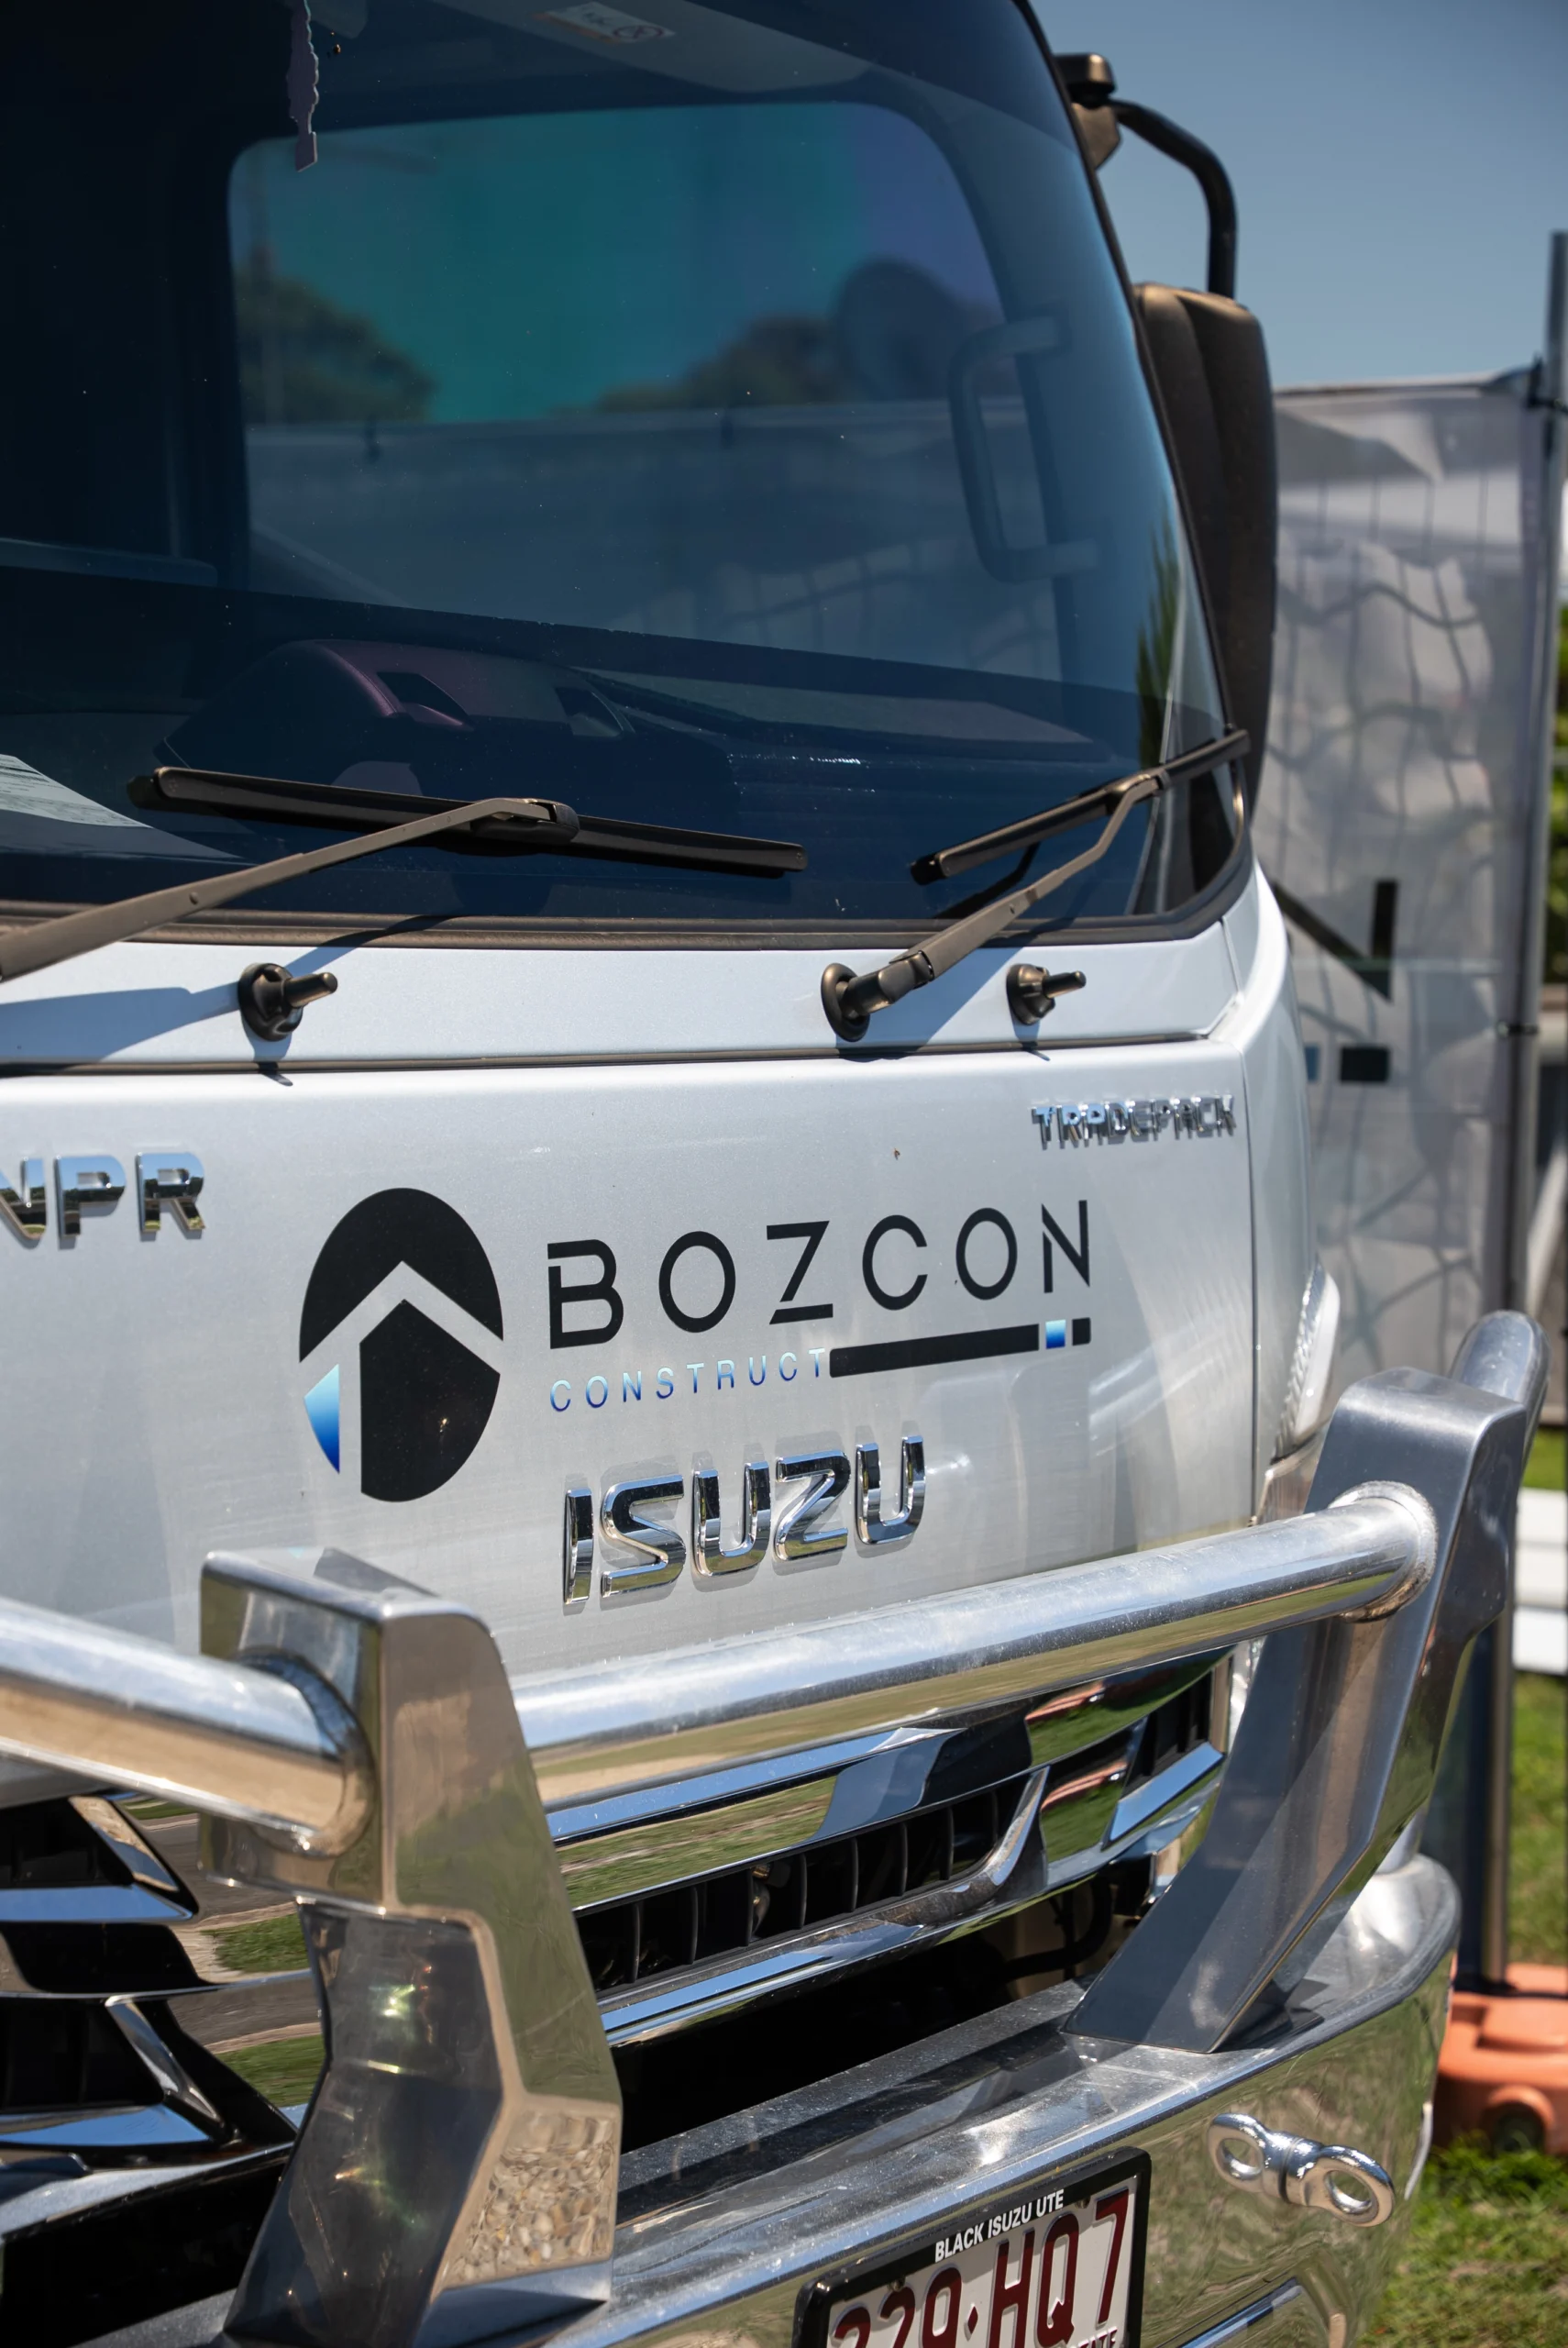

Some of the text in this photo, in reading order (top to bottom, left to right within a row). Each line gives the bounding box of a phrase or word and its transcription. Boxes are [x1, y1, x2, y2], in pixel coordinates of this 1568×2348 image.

[1031, 1095, 1235, 1143] TRADEPACK
[0, 1152, 205, 1239] NPR
[547, 1199, 1091, 1349] BOZCON
[550, 1347, 825, 1412] CONSTRUCT
[561, 1434, 927, 1606] ISUZU
[934, 2188, 1065, 2263] BLACK ISUZU UTE
